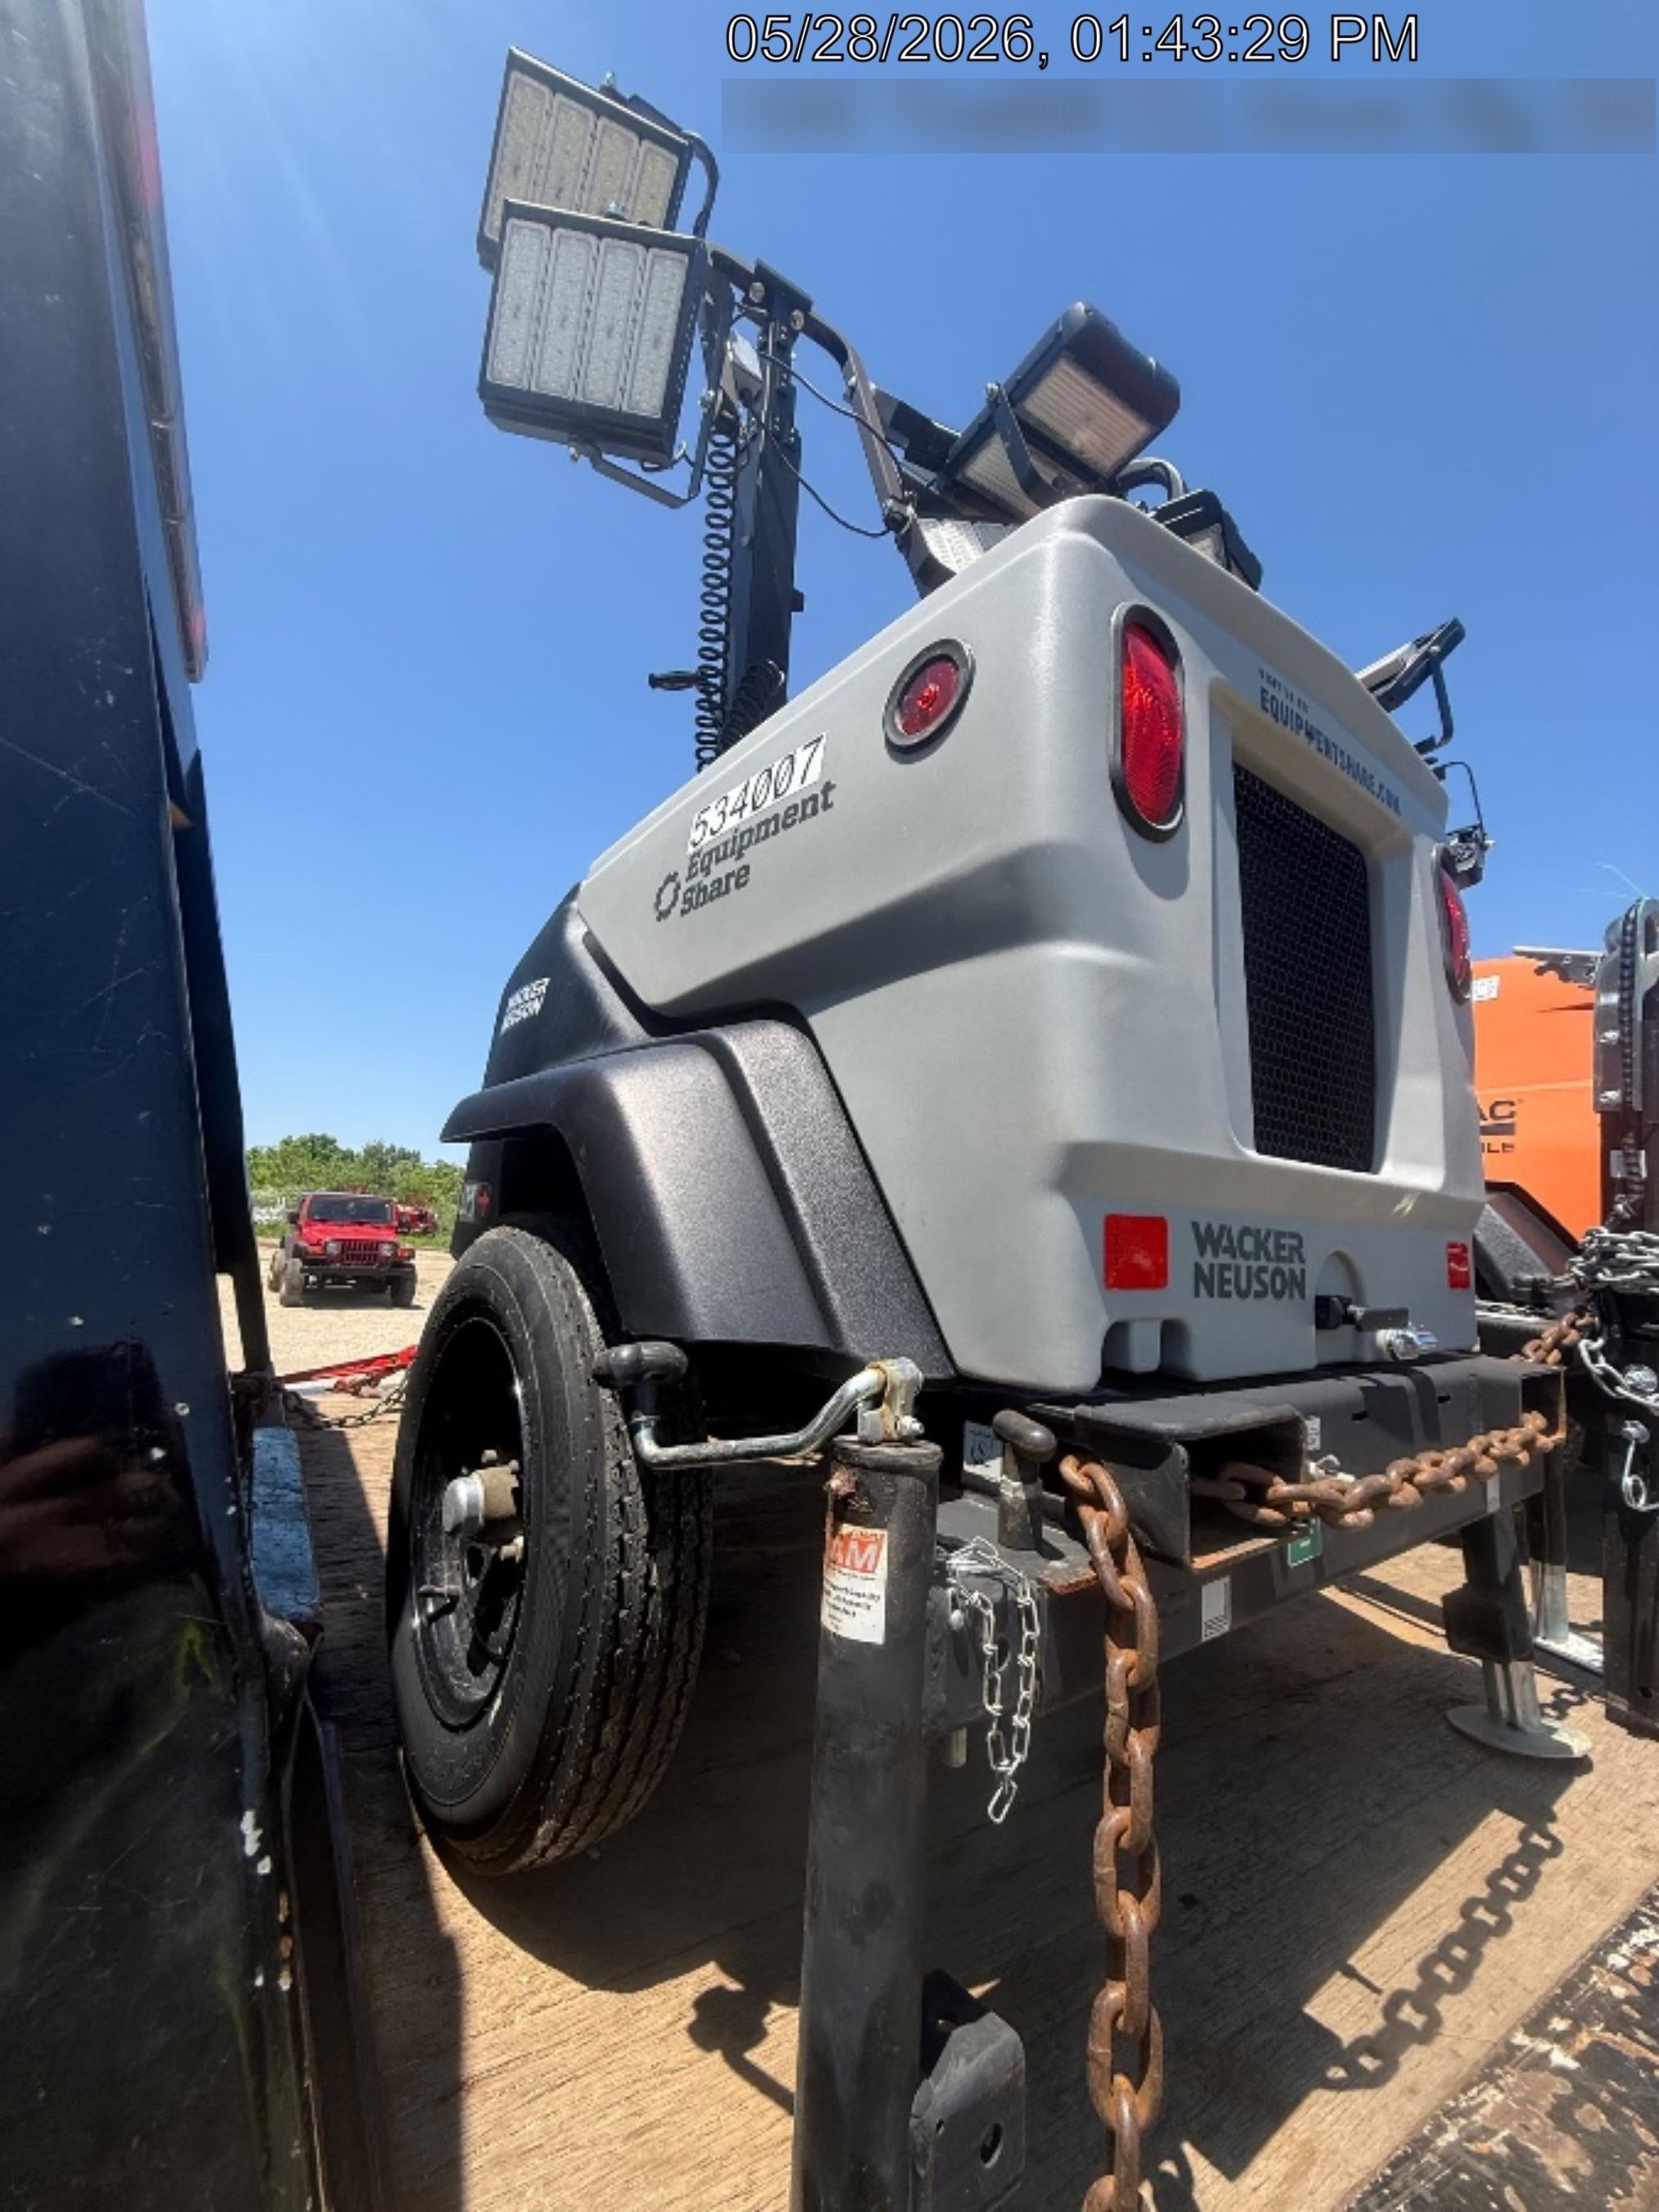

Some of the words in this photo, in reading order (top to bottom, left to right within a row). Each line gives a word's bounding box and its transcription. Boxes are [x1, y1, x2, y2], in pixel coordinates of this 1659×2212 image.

[691, 735, 823, 847] 534007
[686, 781, 836, 882] Equipment
[680, 864, 750, 917] Share
[1190, 1221, 1306, 1264] WACKER
[1193, 1262, 1306, 1300] NEUSON
